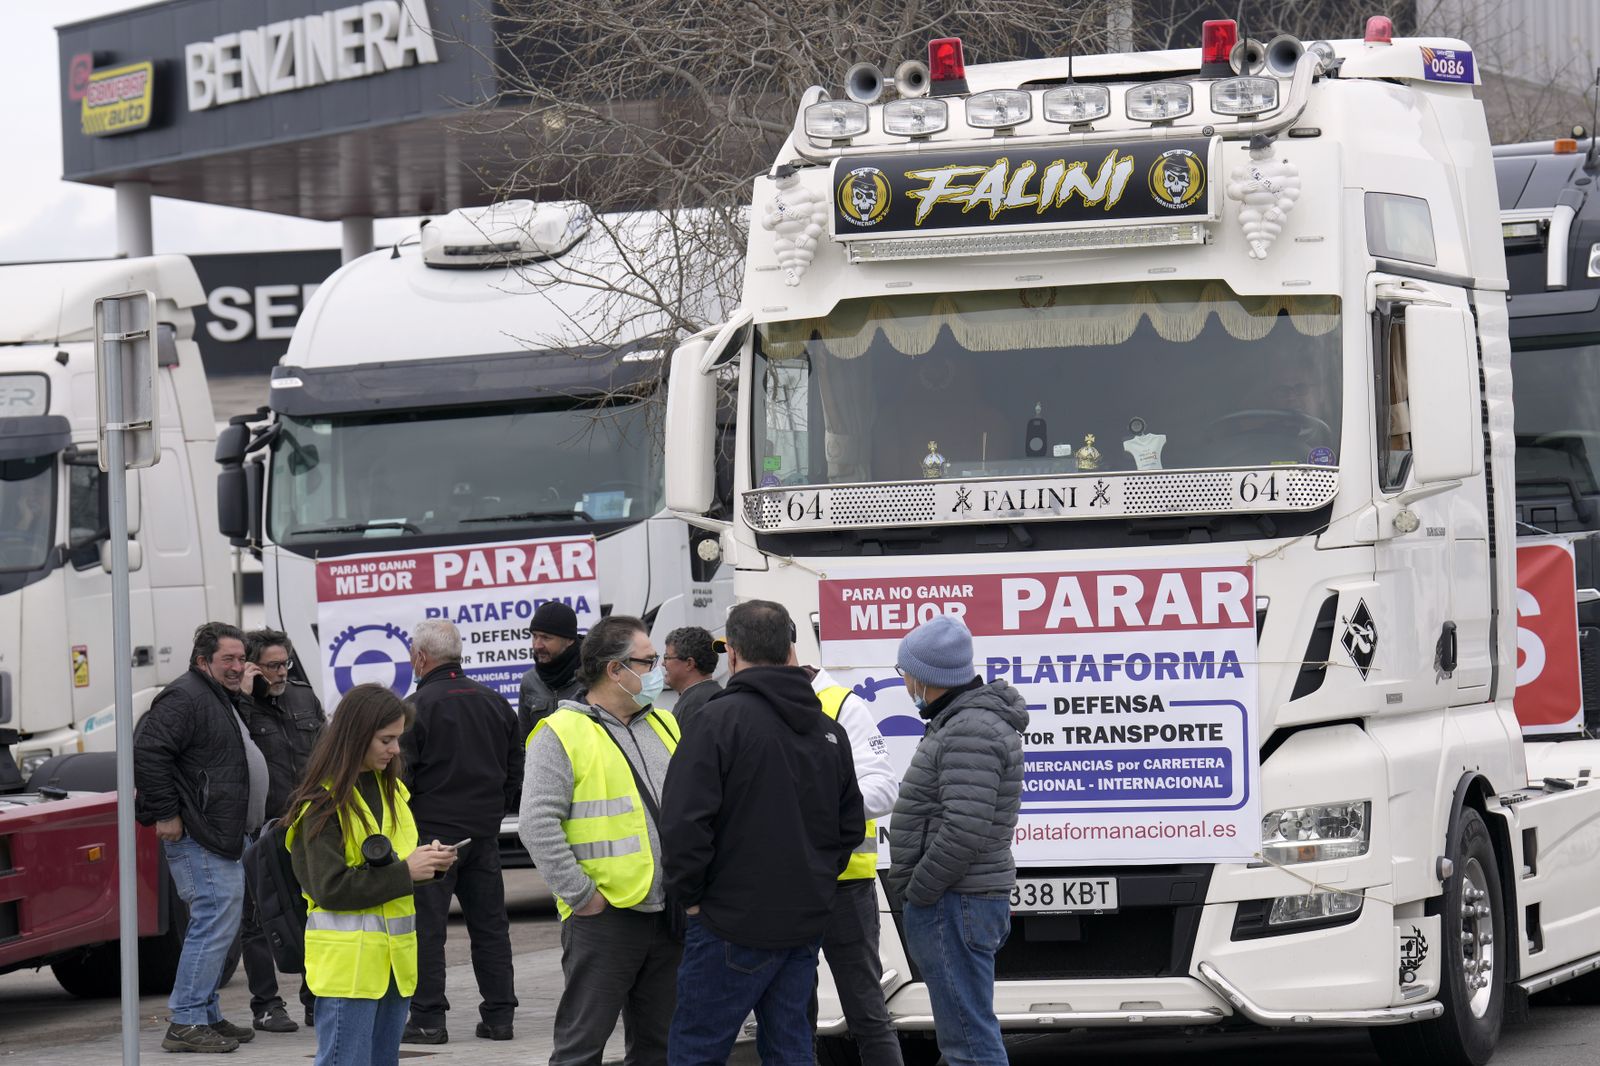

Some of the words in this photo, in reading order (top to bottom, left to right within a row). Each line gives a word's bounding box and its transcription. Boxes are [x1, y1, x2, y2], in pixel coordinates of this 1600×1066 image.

[185, 0, 439, 112] BENZINERA
[1432, 58, 1465, 75] 0086
[108, 103, 145, 126] auto
[904, 149, 1134, 227] FALINI
[983, 486, 1079, 512] FALINI
[1239, 472, 1280, 503] 64
[786, 491, 825, 522] 64
[330, 564, 359, 576] PARA
[360, 562, 377, 574] NO
[379, 559, 417, 572] GANAR
[432, 541, 594, 590] PARAR
[335, 571, 413, 596] MEJOR
[842, 587, 885, 601] PARA
[889, 586, 913, 599] NO
[917, 584, 974, 599] GANAR
[1000, 570, 1250, 631] PARAR
[471, 628, 531, 644] DEFENS
[986, 649, 1244, 685] PLATAFORMA
[1053, 694, 1165, 716] DEFENSA
[1022, 732, 1055, 745] TOR
[1062, 722, 1224, 745] TRANSPORTE
[1024, 760, 1114, 773] MERCANCIAS
[1117, 760, 1140, 773] por
[1143, 758, 1225, 770] CARRETERA
[1021, 777, 1086, 792] ACIONAL
[1098, 775, 1224, 791] INTERNACIONAL
[1015, 820, 1237, 845] plataformanacional.es
[1010, 882, 1054, 907] 338
[1063, 881, 1110, 906] KBT
